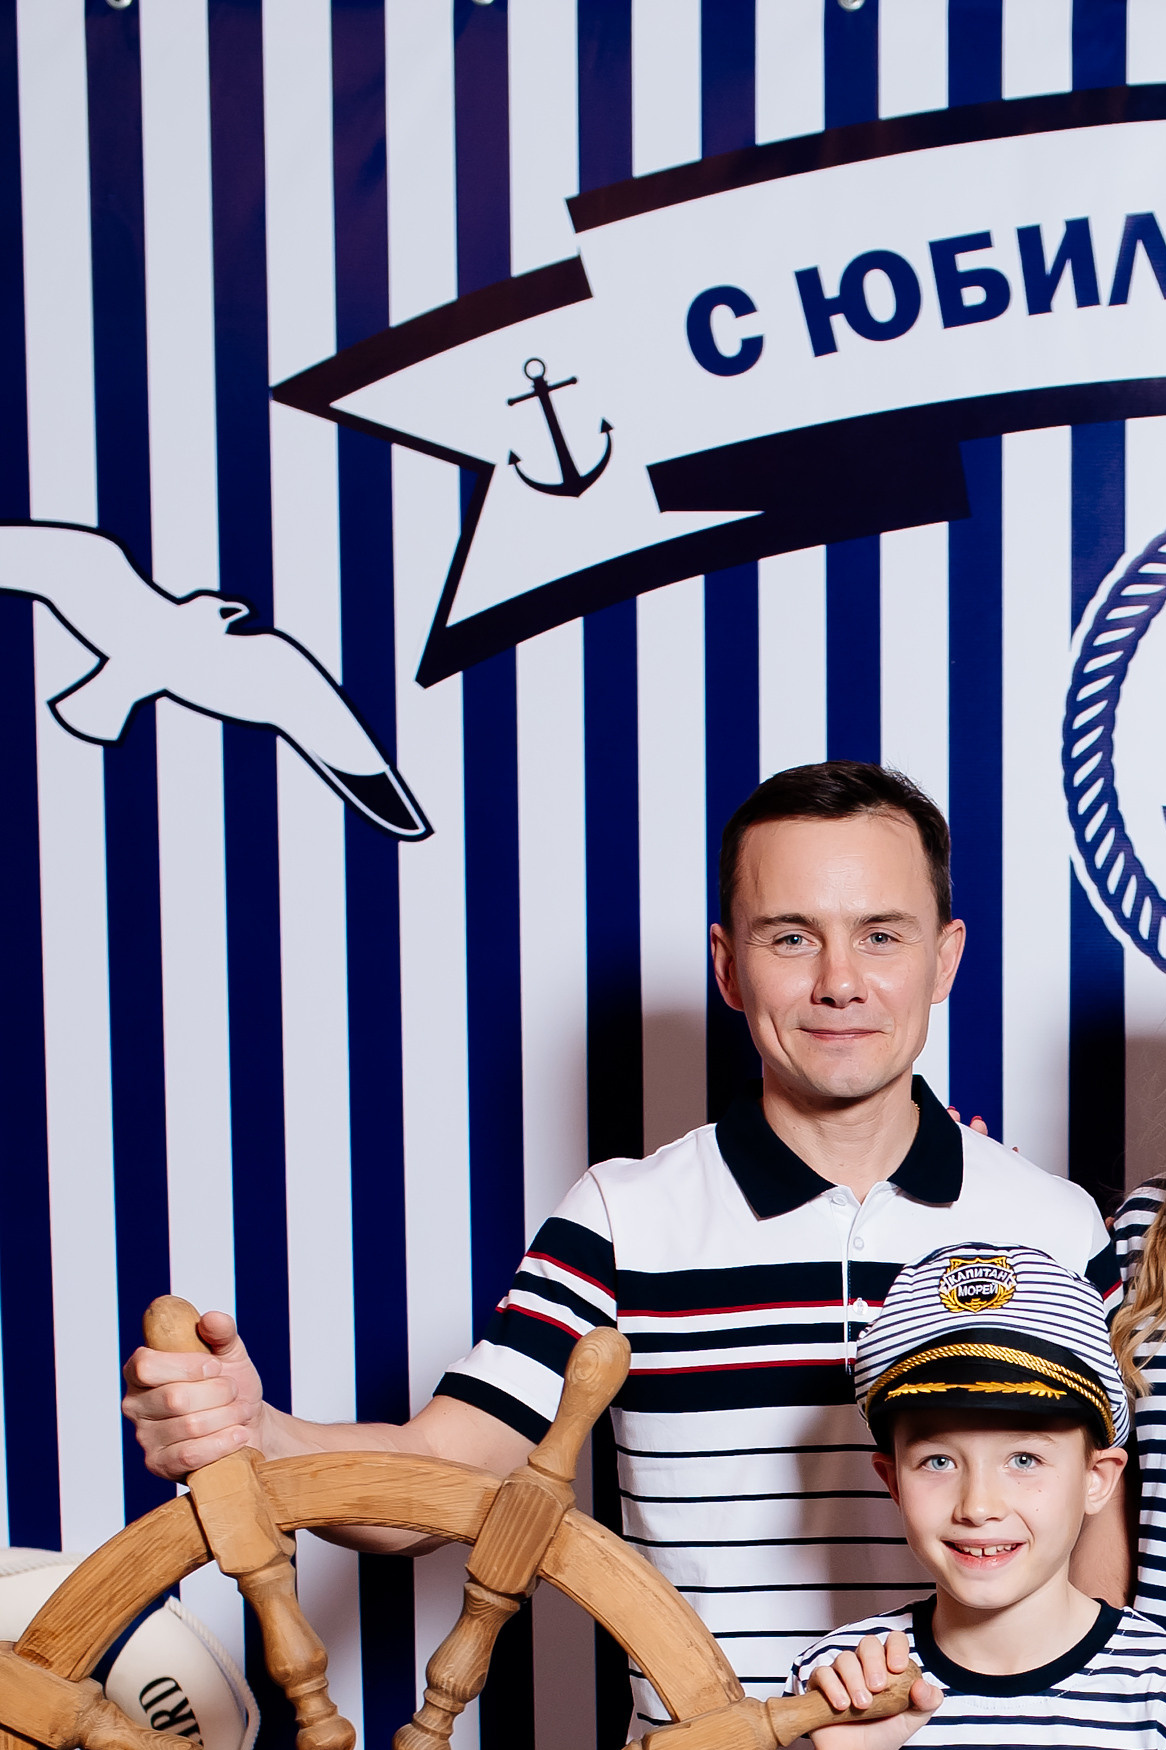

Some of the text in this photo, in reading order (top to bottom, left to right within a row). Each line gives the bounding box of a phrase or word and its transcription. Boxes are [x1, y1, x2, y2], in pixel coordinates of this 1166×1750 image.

[684, 283, 766, 378] С
[947, 1267, 1008, 1286] КАПИТАН
[957, 1282, 998, 1297] МОРЕЙ
